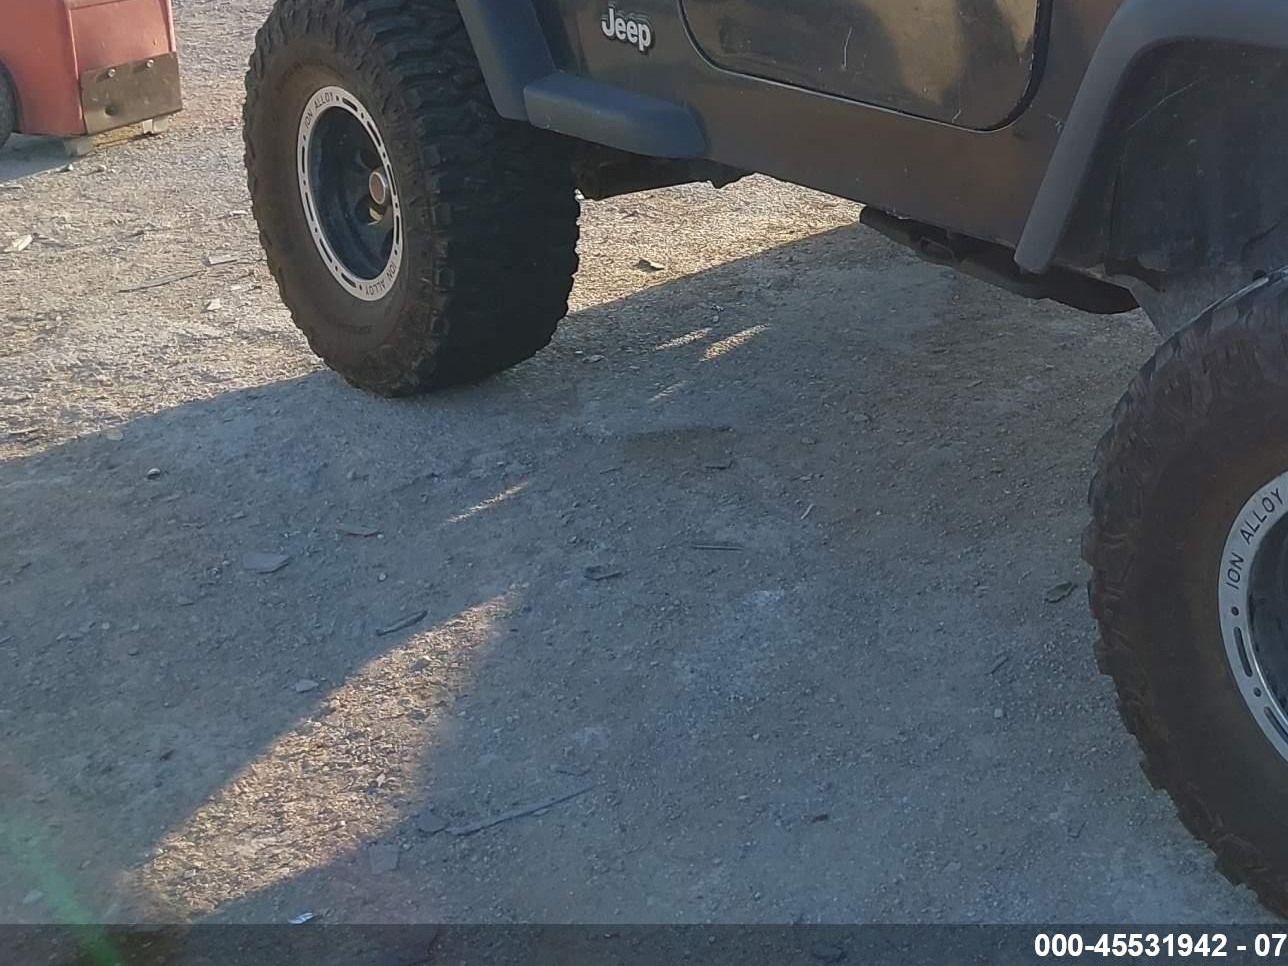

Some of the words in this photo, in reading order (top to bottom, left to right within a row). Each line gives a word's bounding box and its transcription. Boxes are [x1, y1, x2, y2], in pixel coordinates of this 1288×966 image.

[601, 6, 653, 52] Jeep
[1226, 553, 1245, 590] ION
[1240, 488, 1285, 546] ALLOY
